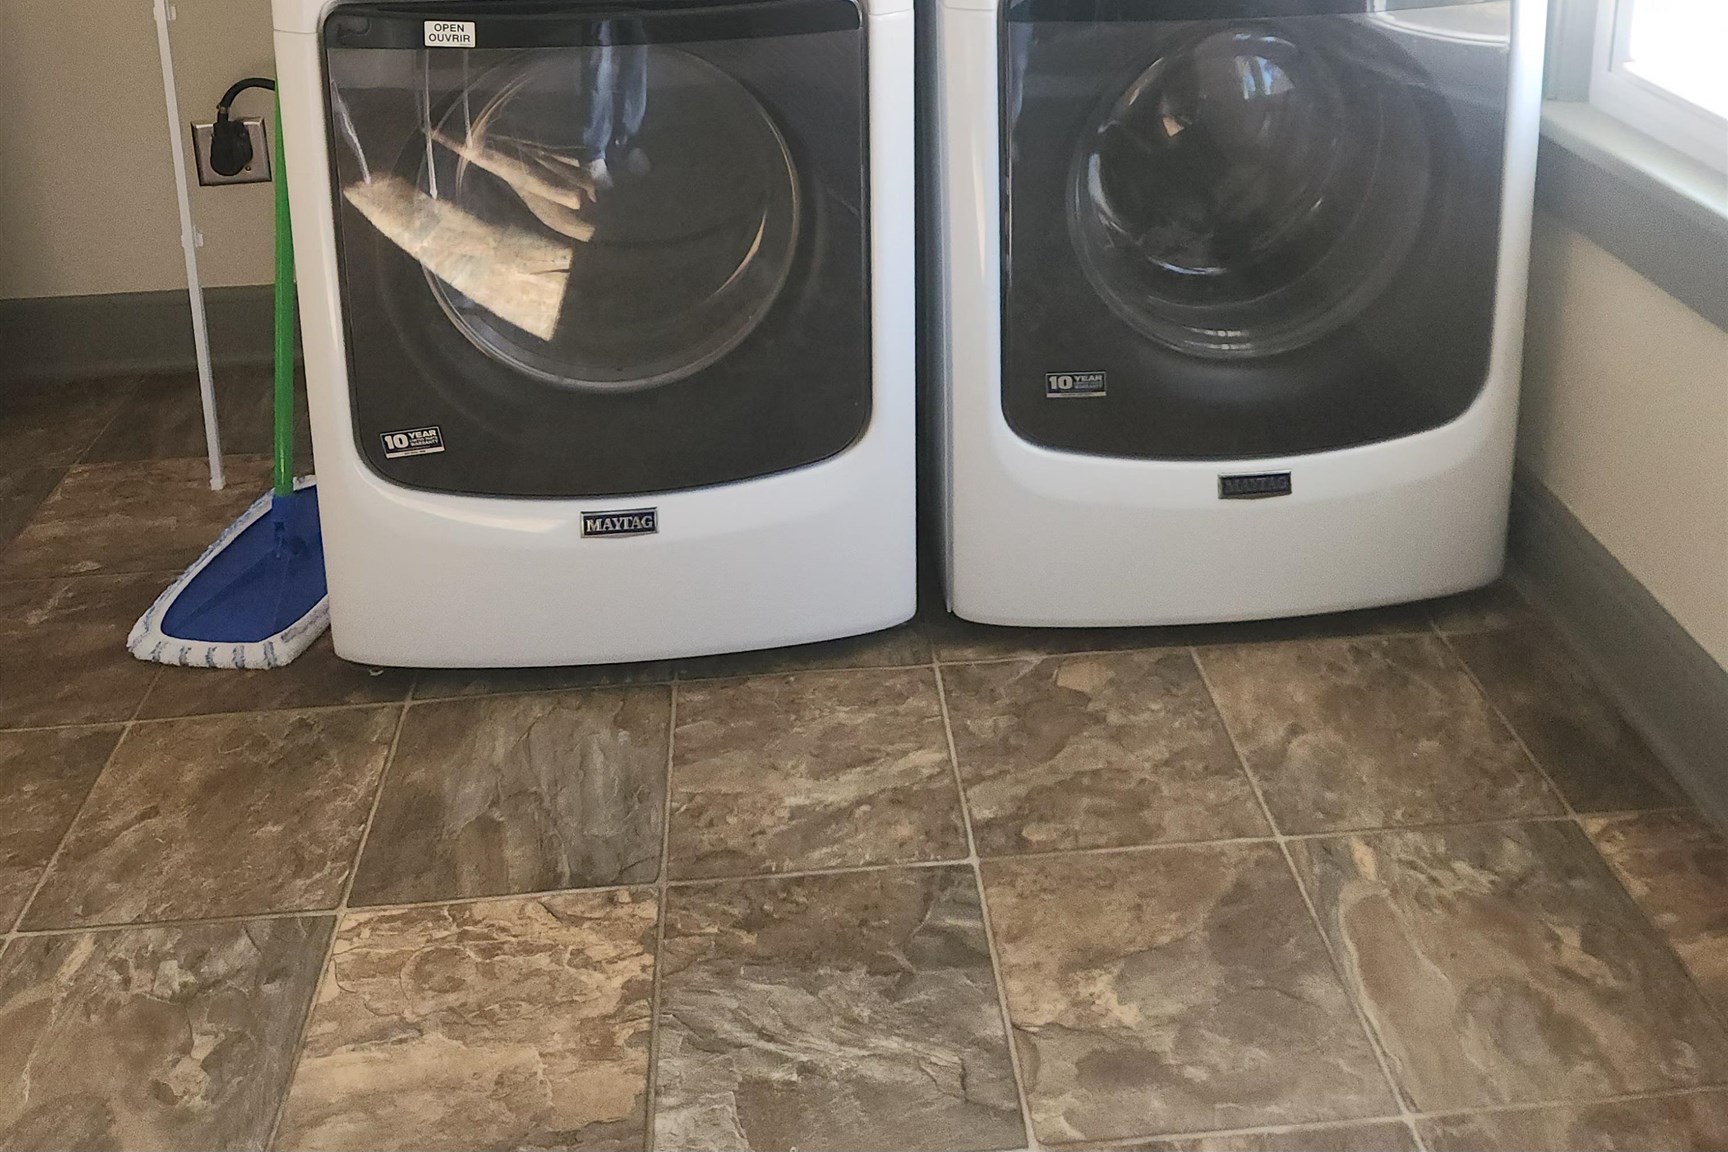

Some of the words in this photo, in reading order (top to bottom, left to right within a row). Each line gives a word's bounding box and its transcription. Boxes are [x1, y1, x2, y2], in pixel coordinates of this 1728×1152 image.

[434, 23, 465, 32] OPEN
[428, 33, 471, 43] OUVRIR
[1049, 375, 1073, 389] 10
[1073, 374, 1103, 382] YEAR
[384, 433, 409, 450] 10
[408, 429, 437, 439] YEAR
[586, 515, 654, 532] MAYTAG
